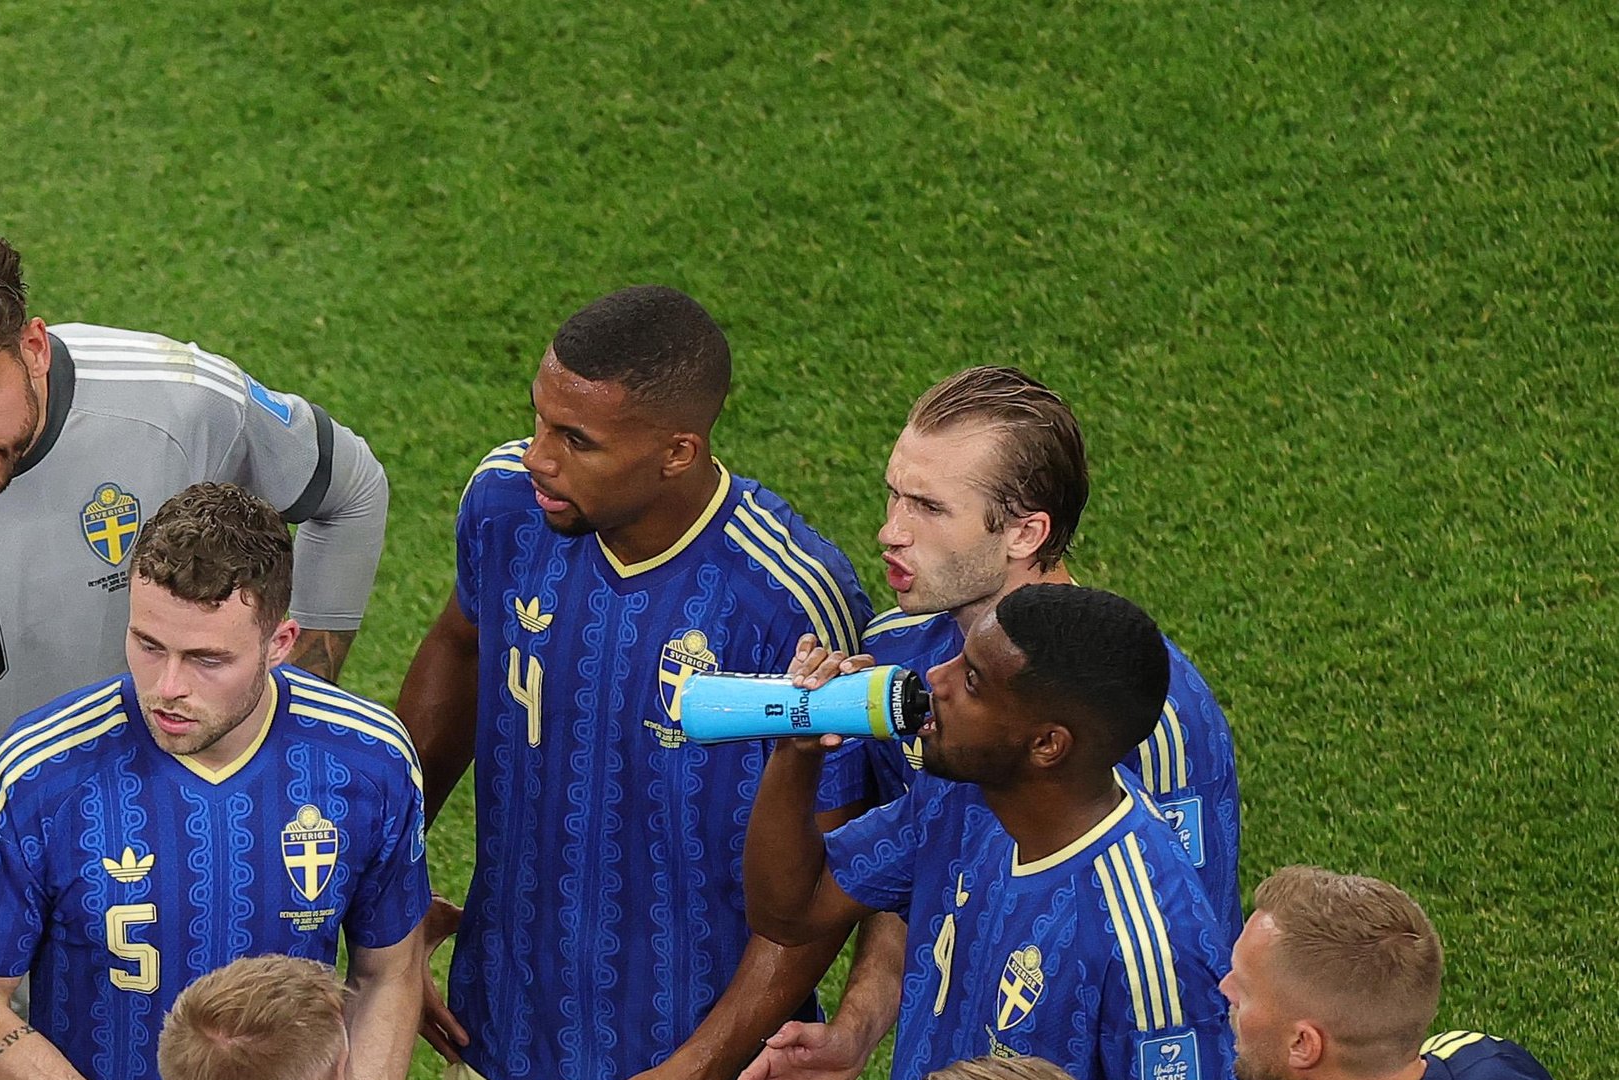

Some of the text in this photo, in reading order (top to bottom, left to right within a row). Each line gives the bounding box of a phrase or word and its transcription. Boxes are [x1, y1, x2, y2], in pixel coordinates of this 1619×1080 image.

[89, 505, 130, 520] SVERIGE
[669, 650, 709, 670] SVERIGE
[508, 645, 543, 748] 4
[891, 680, 906, 730] POWERADE
[289, 831, 330, 842] SVERIGE
[106, 903, 160, 995] 5
[933, 913, 956, 1017] 9
[1011, 960, 1037, 989] SVERIGE
